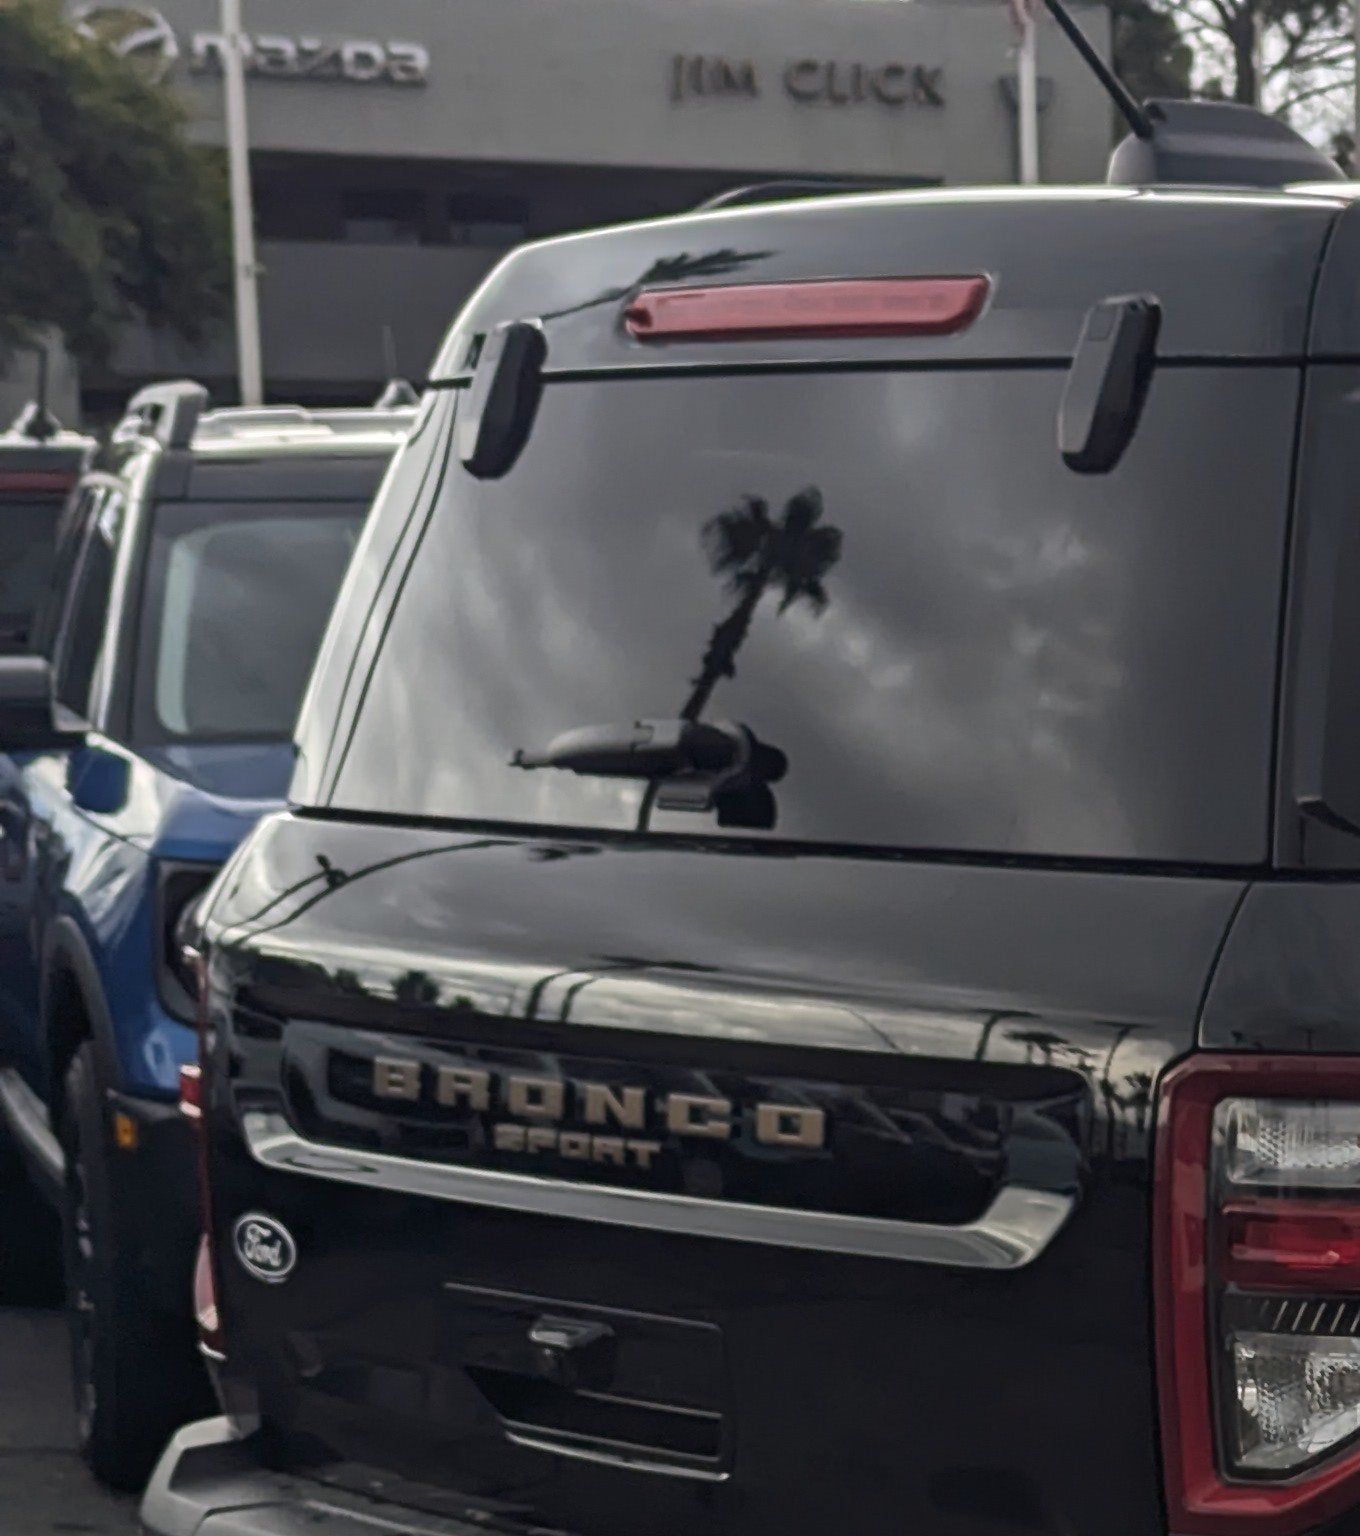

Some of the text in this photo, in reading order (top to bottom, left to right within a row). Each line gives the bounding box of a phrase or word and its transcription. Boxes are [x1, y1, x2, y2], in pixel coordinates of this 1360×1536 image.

[670, 53, 946, 107] JIM CLICK
[373, 1054, 825, 1148] BRONCO
[493, 1123, 662, 1170] SPORT
